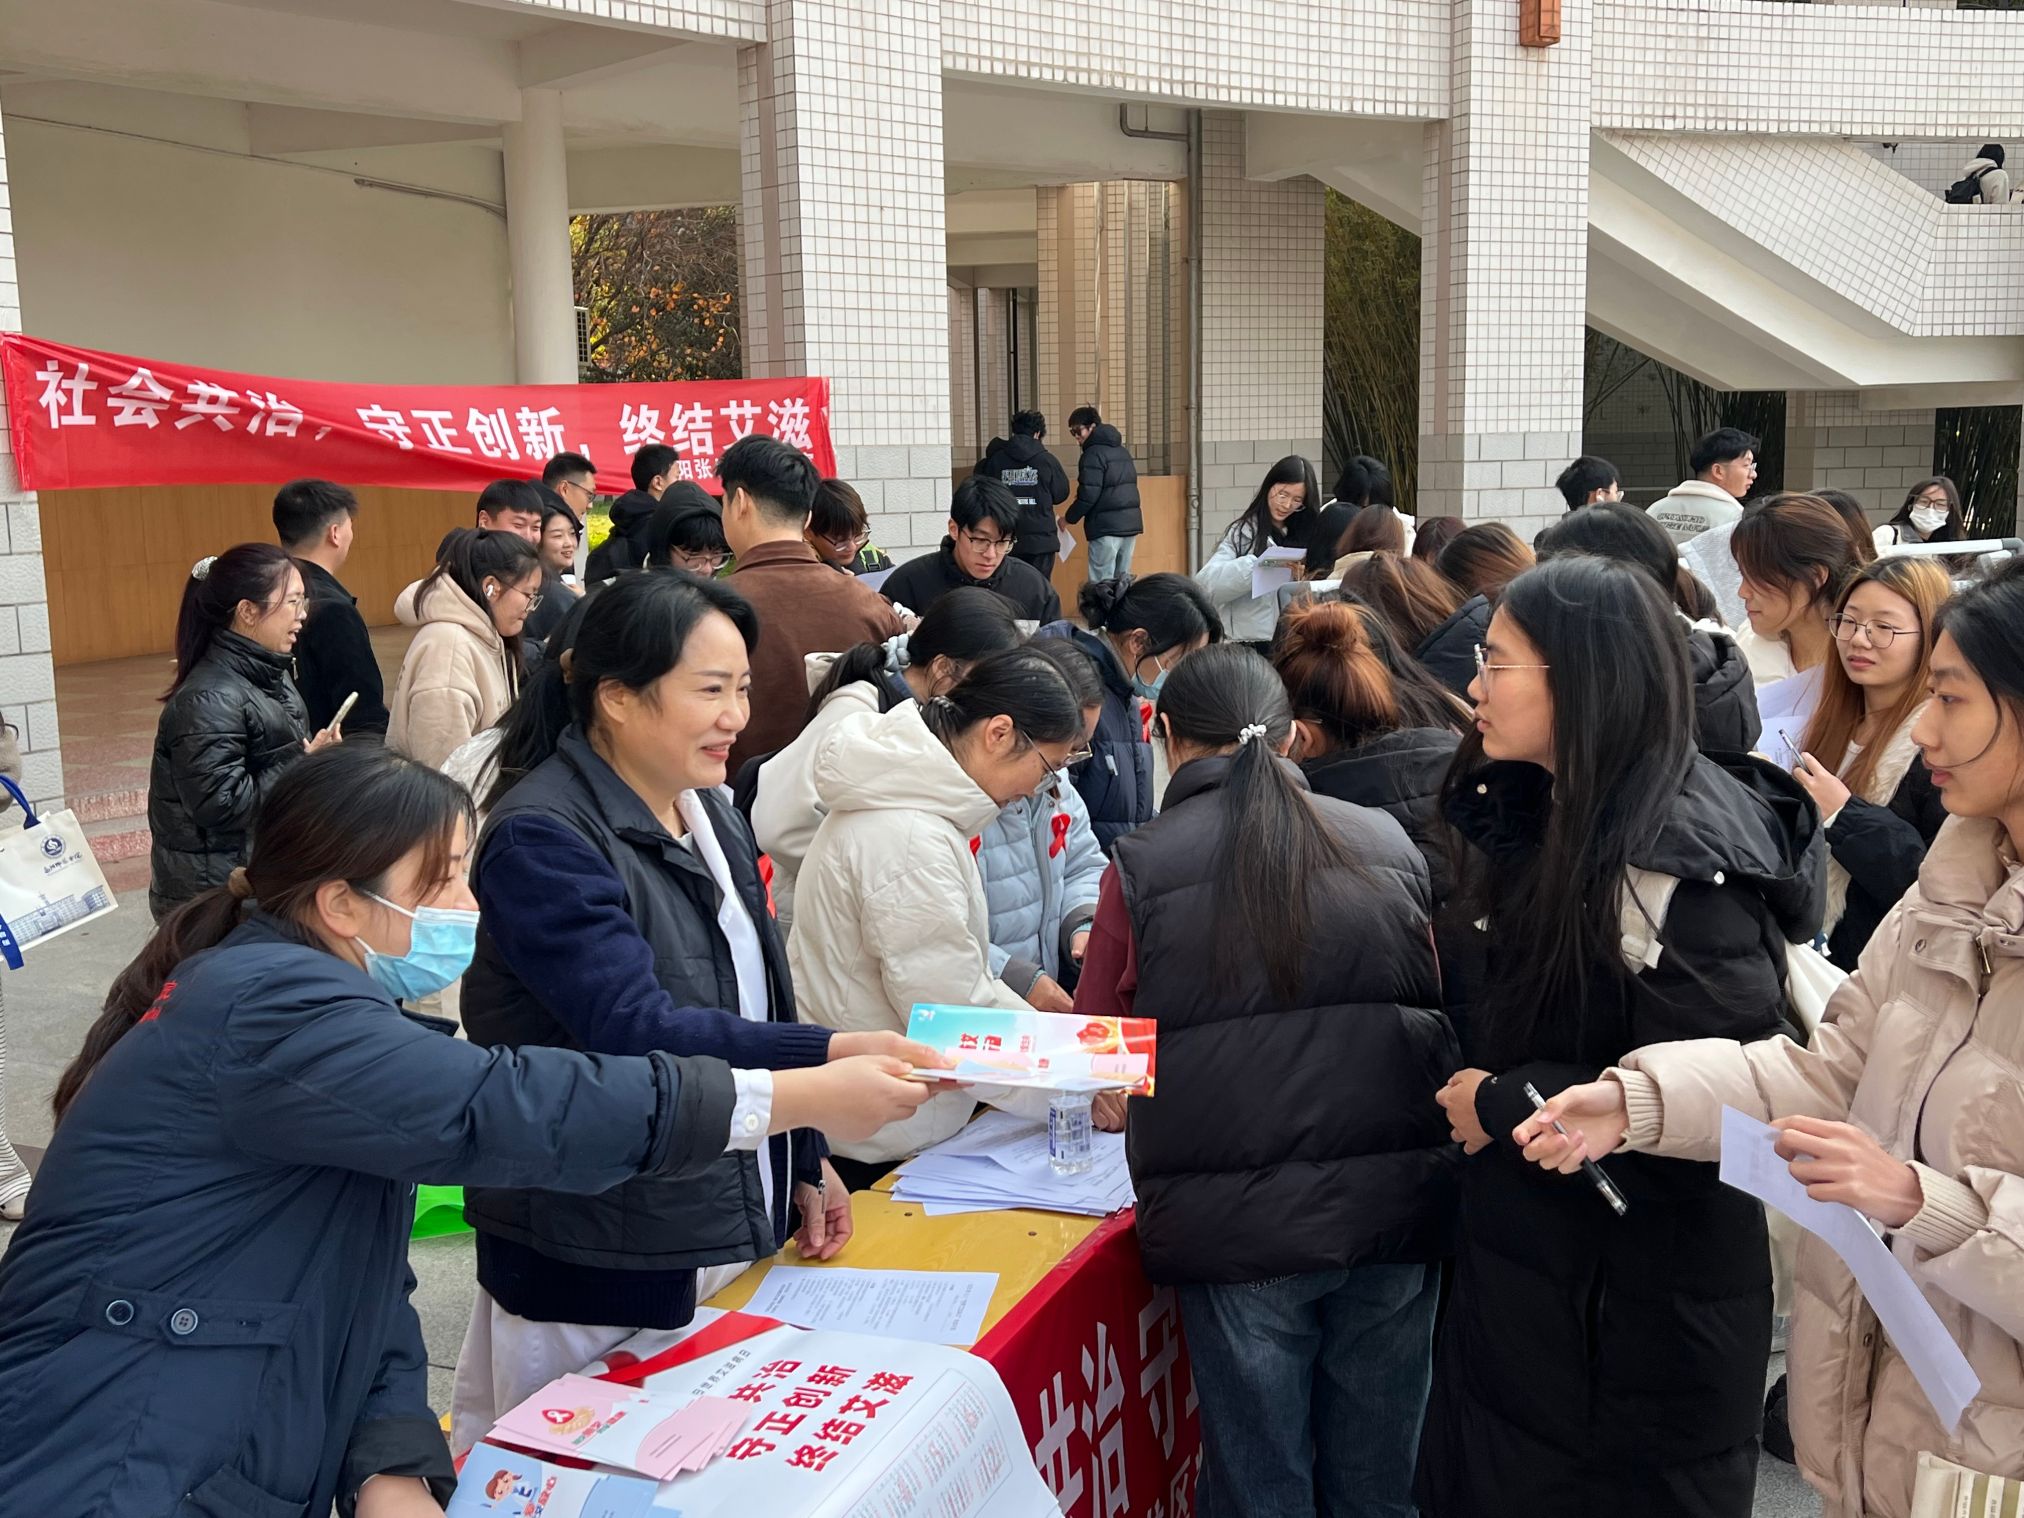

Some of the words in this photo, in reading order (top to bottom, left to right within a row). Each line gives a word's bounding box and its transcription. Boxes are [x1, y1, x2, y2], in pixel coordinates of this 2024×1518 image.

[677, 458, 720, 480] 阳张
[726, 1365, 857, 1460] 守正创新
[728, 1360, 802, 1402] 共治
[785, 1371, 914, 1472] 终结艾滋
